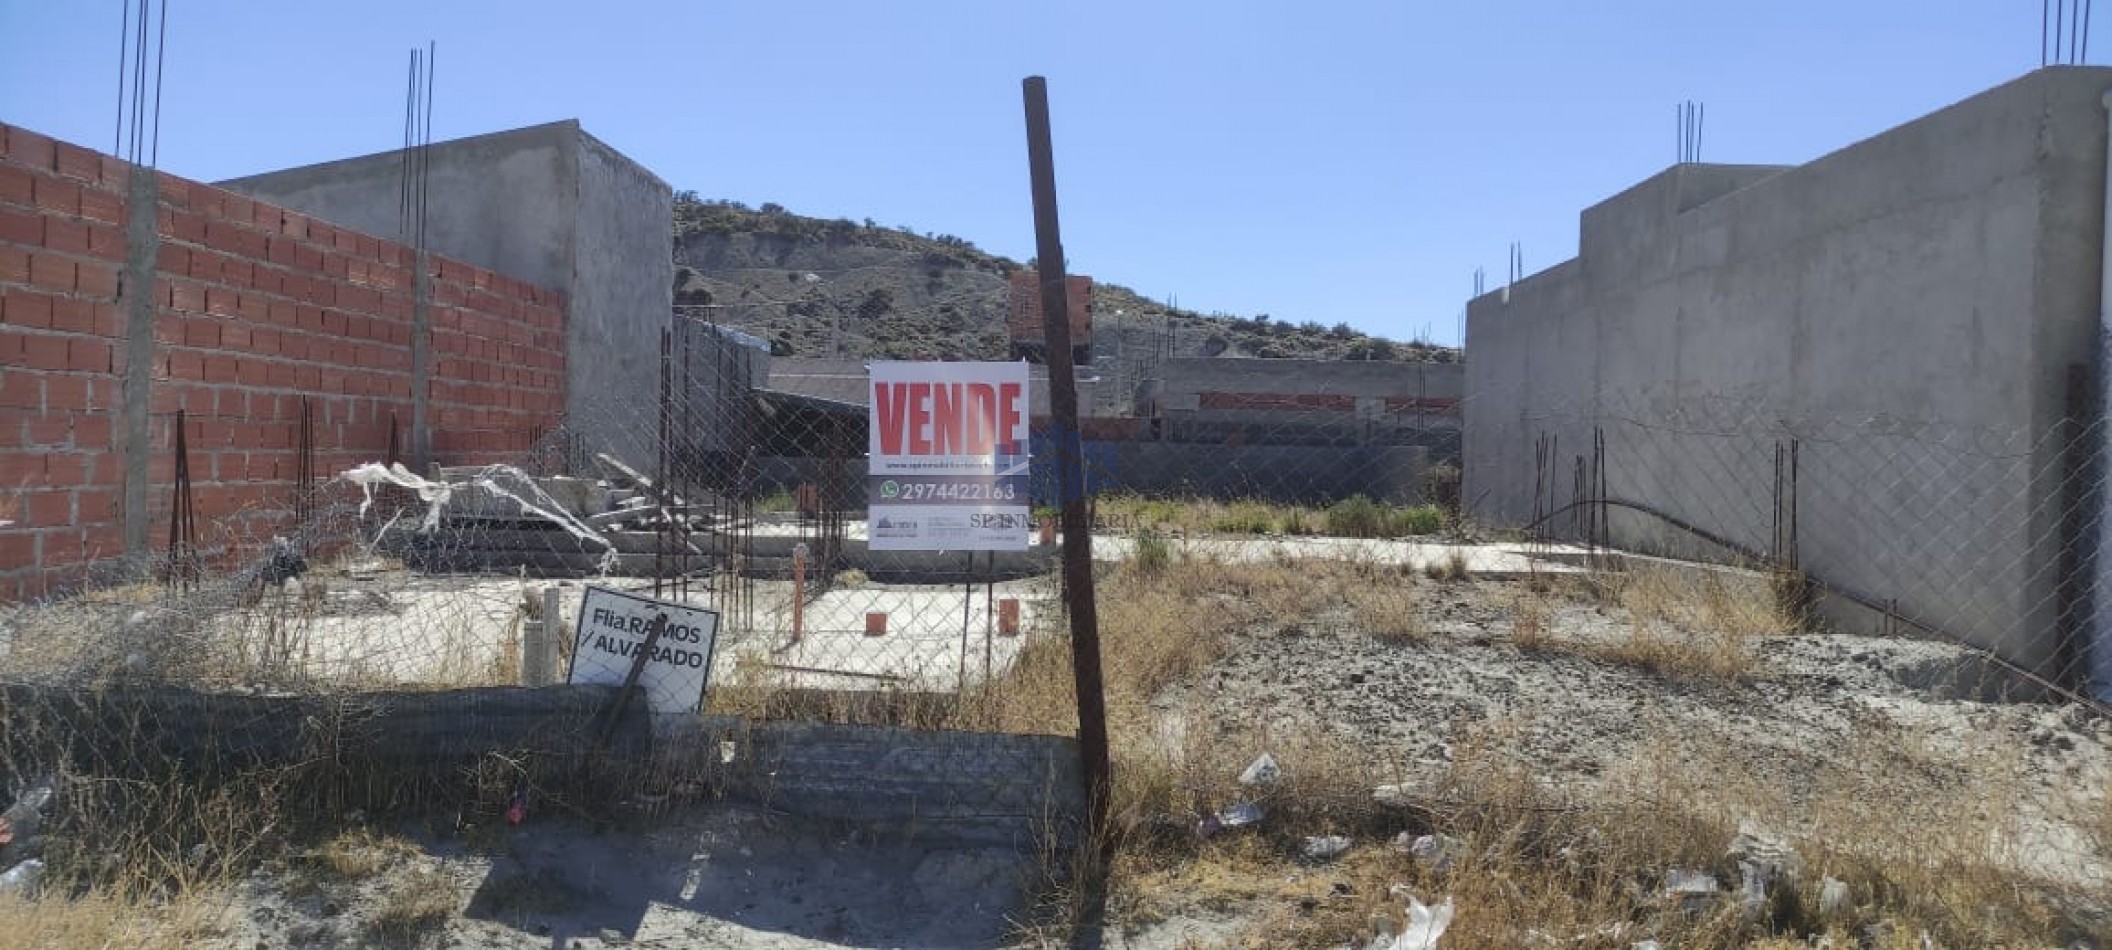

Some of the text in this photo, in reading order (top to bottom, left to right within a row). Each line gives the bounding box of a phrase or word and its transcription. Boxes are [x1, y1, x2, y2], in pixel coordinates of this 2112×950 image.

[875, 382, 1022, 456] VENDE
[901, 483, 1015, 500] 2974422163
[593, 607, 701, 644] Flia.RAMOS
[594, 635, 702, 668] ALVARADO
